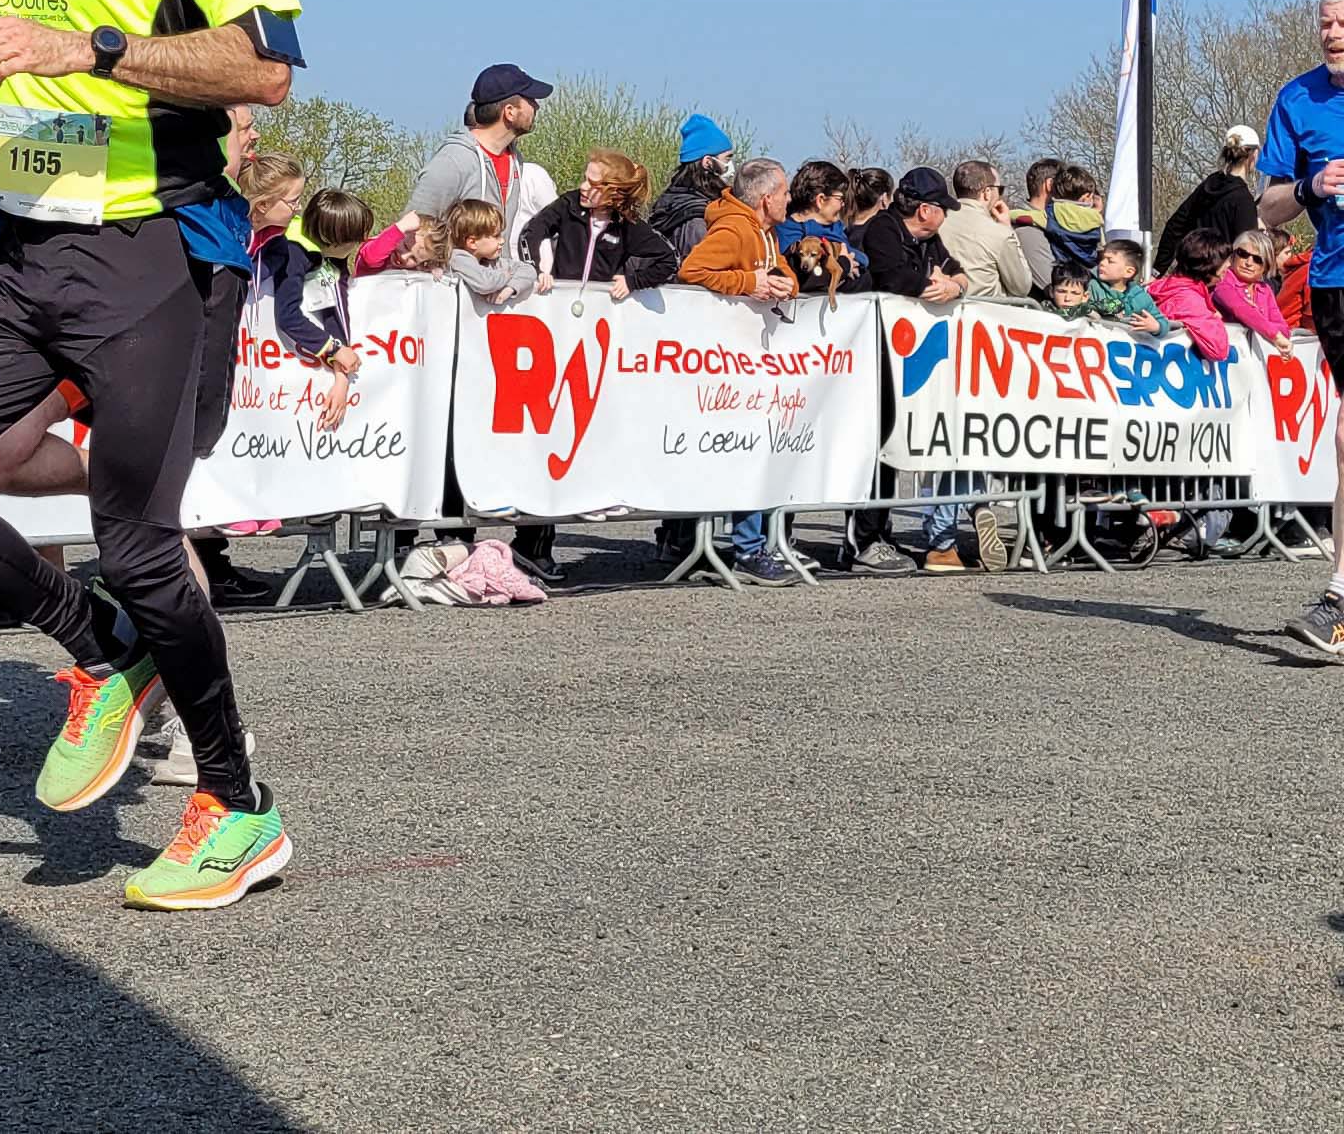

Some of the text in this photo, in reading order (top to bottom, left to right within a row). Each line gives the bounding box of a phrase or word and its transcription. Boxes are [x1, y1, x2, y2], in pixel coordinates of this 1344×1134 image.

[9, 146, 62, 176] 1155
[617, 340, 853, 377] La Roche-sur-Yon
[956, 319, 1239, 409] INTERSPORT
[268, 388, 291, 411] et
[487, 313, 610, 481] Ry
[697, 383, 807, 430] Ville et Agglo
[297, 420, 406, 460] Vendée
[663, 423, 688, 455] Le
[767, 418, 816, 456] Vendée
[907, 412, 1232, 463] LA ROCHE SUR YON
